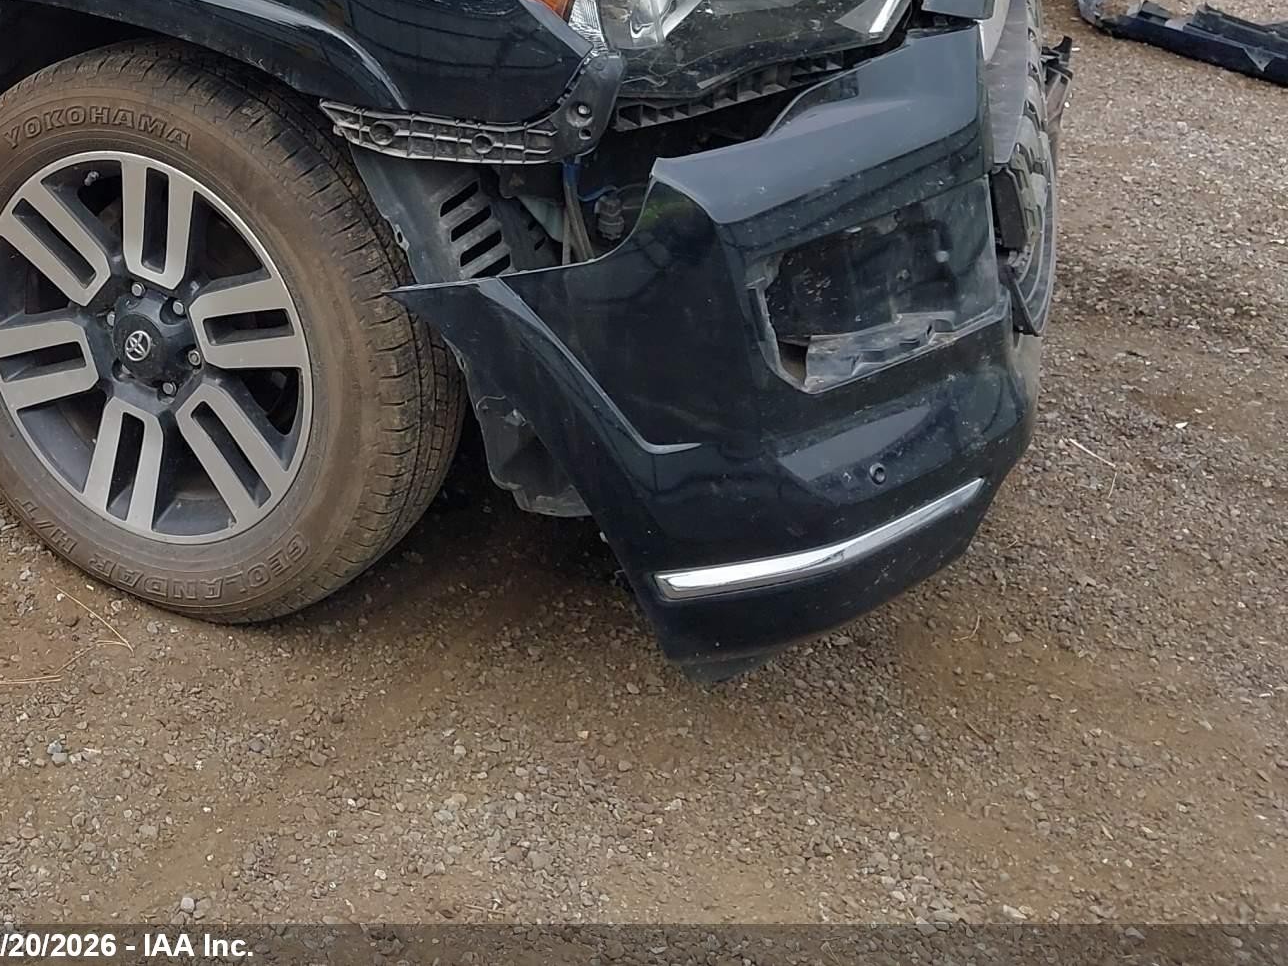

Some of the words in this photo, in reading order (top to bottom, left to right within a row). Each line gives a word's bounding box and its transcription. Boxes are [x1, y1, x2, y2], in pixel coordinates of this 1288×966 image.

[4, 106, 192, 151] YOKOHAMA
[14, 498, 78, 555] H/T
[87, 533, 310, 599] GEOLANDAR
